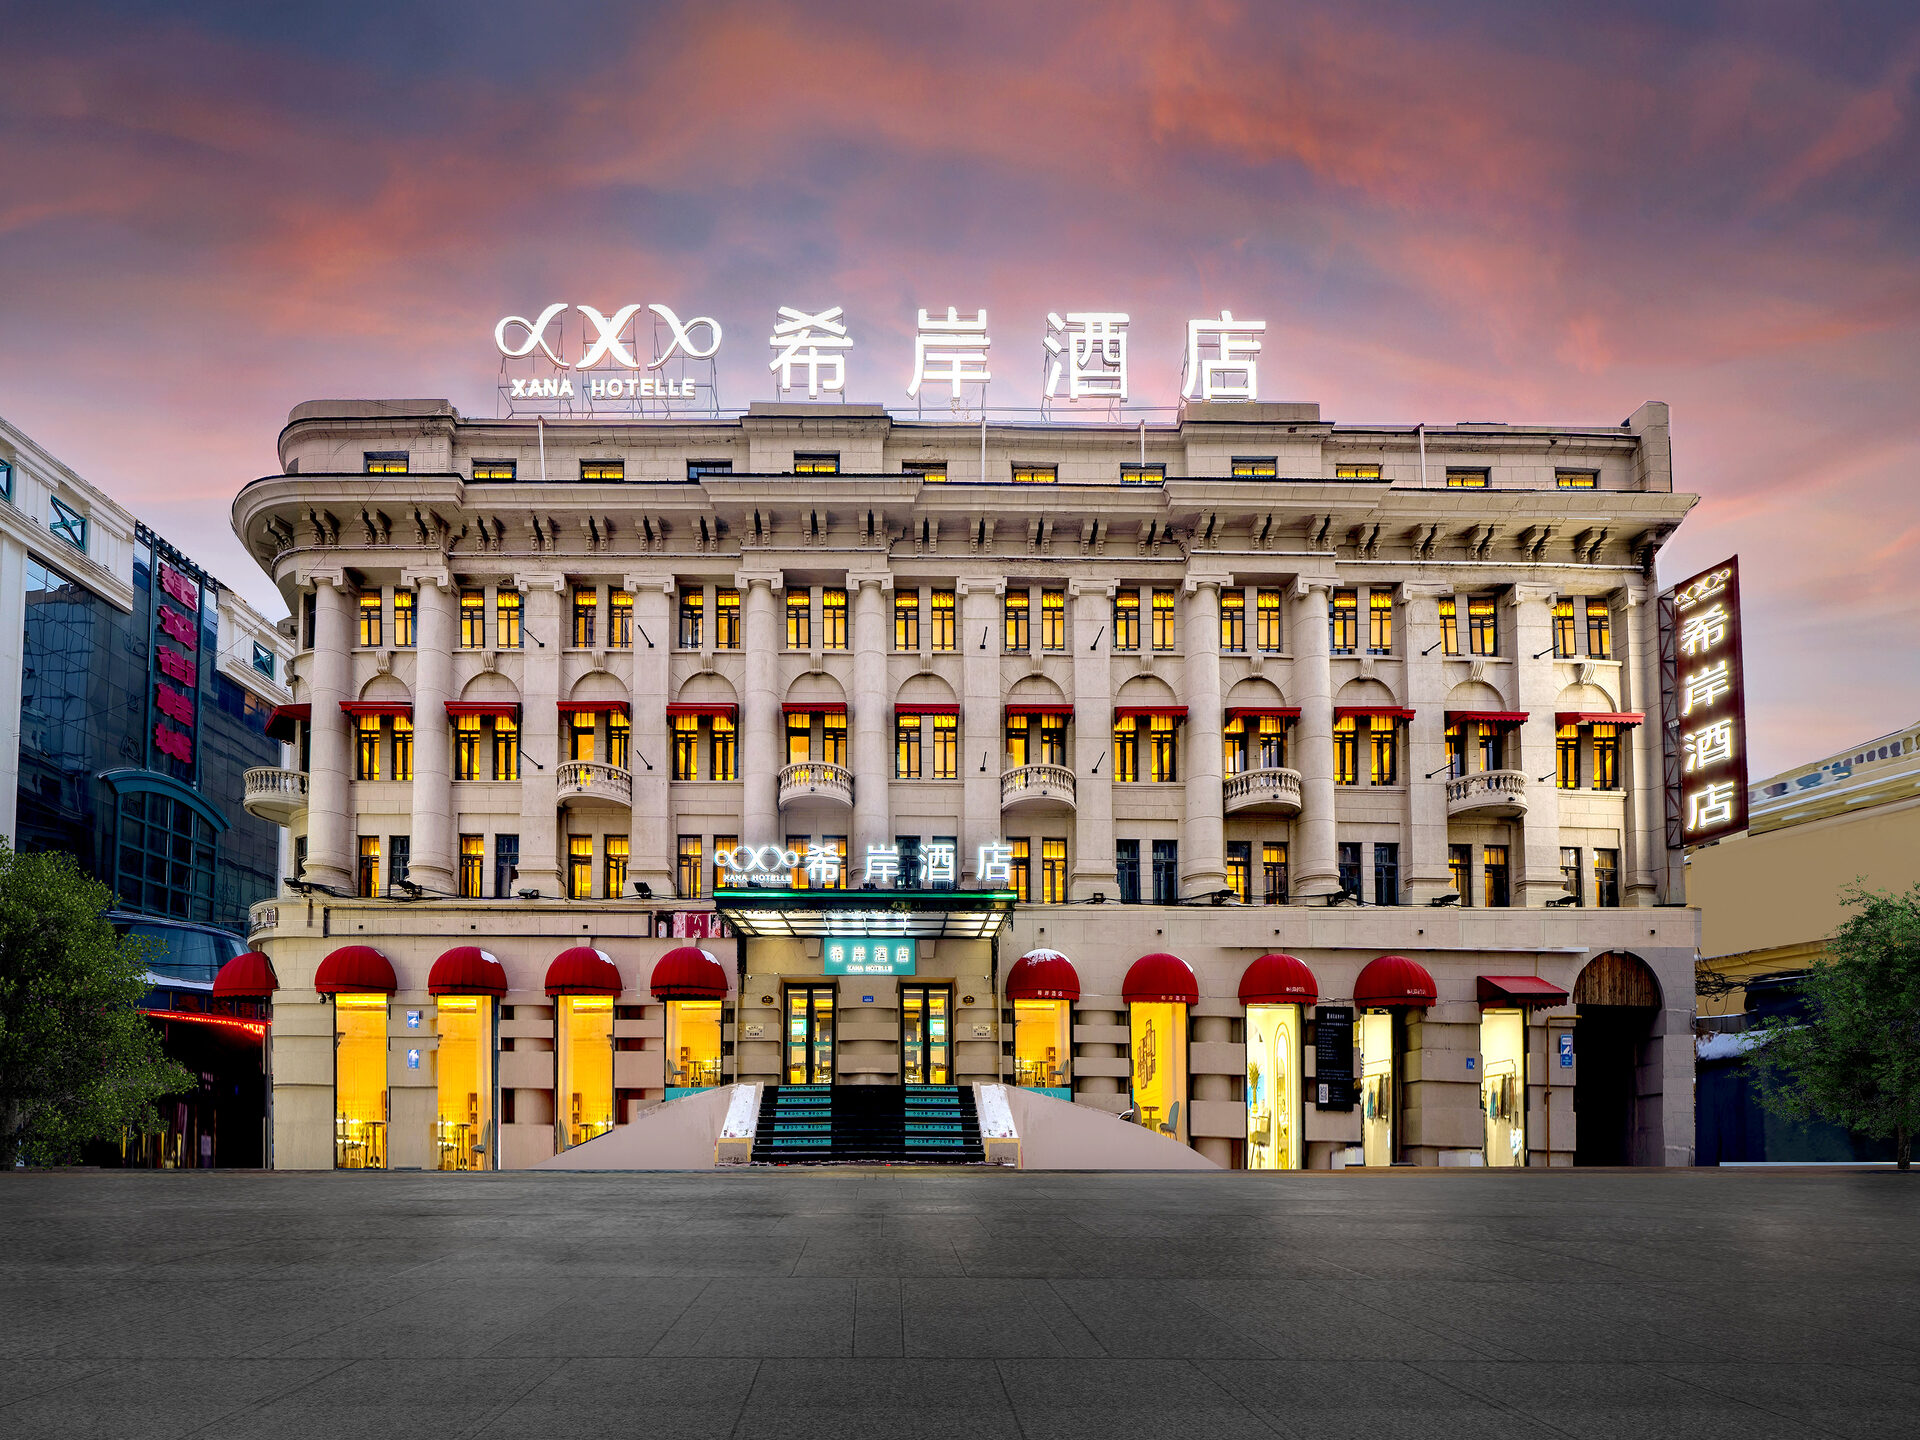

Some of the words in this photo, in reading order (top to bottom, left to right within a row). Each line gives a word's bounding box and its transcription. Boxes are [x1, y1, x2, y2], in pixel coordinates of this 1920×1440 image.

[769, 306, 1266, 404] 希岸酒店
[510, 378, 574, 399] XANA
[590, 377, 696, 399] HOTELLE
[1681, 603, 1734, 831] 希岸酒店
[805, 842, 1012, 883] 希岸酒店
[723, 874, 748, 883] XANA
[752, 874, 793, 883] HOTELLE
[829, 945, 910, 963] 希岸酒店
[846, 964, 864, 973] XANA
[865, 964, 893, 973] HOTELLE
